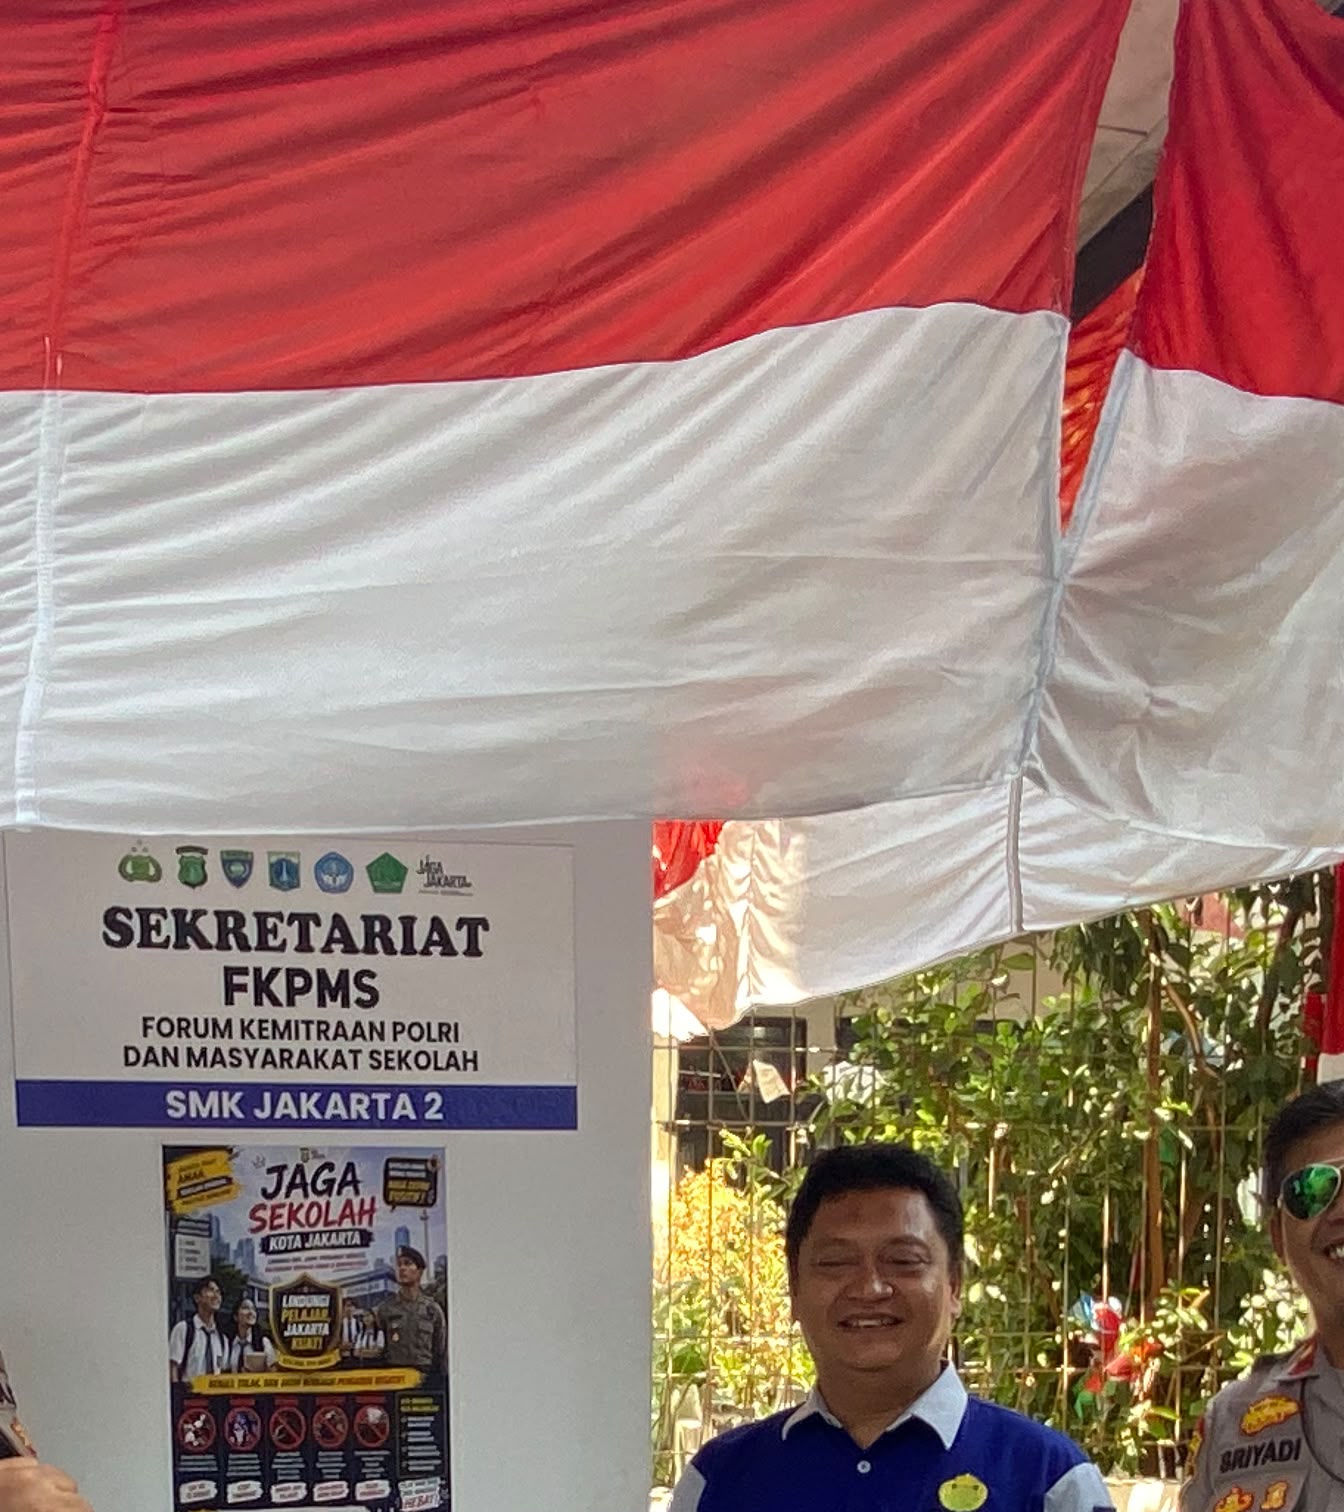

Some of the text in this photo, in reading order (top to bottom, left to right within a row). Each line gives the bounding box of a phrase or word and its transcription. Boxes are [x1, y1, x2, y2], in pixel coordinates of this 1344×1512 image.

[102, 906, 490, 957] SEKRETARIAT
[223, 965, 380, 1009] FKPMS
[141, 1016, 460, 1043] FORUM KEMITRAAN POLRI
[123, 1045, 479, 1071] DAN MASYARAKAT SEKOLAH
[166, 1089, 444, 1121] SMK JAKARTA 2
[260, 1160, 362, 1201] JAGA
[248, 1195, 378, 1235] SEKOLAH
[268, 1233, 302, 1251] KOTA
